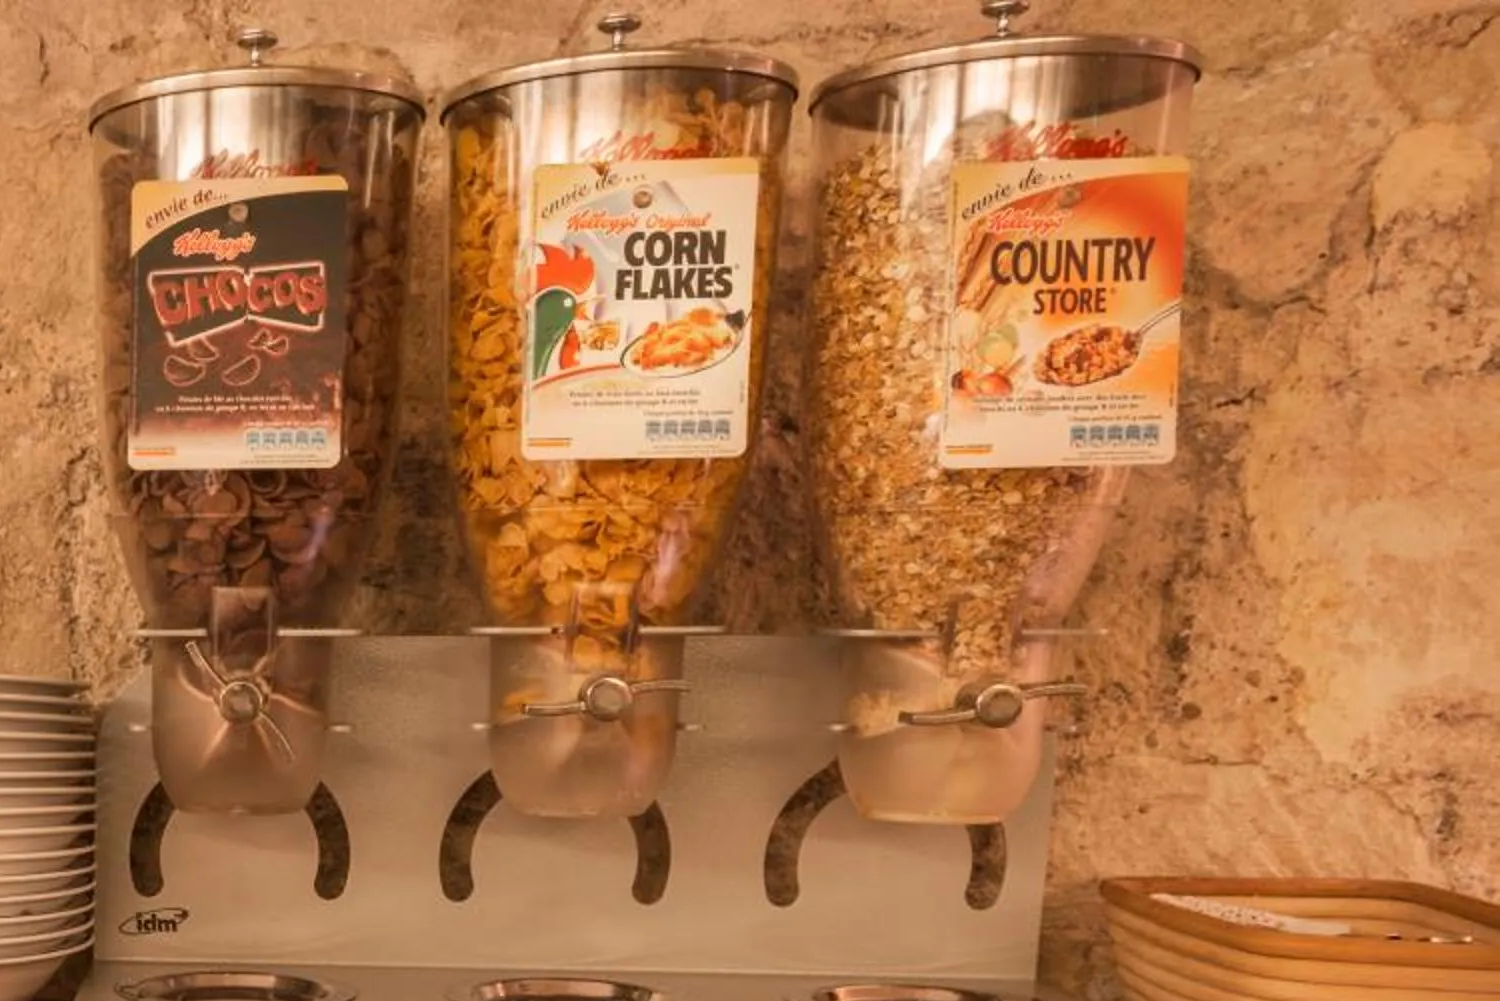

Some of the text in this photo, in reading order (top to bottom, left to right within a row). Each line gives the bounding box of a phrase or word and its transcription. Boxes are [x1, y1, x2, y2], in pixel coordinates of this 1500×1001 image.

[145, 197, 188, 229] envie
[541, 186, 591, 220] envie
[961, 186, 1012, 221] envie
[646, 211, 712, 231] Original
[623, 229, 727, 266] CORN
[990, 236, 1156, 286] COUNTRY
[151, 269, 327, 327] CHOCOS
[615, 265, 734, 301] FLAKES
[1032, 287, 1108, 315] STORE
[136, 912, 178, 932] idm
